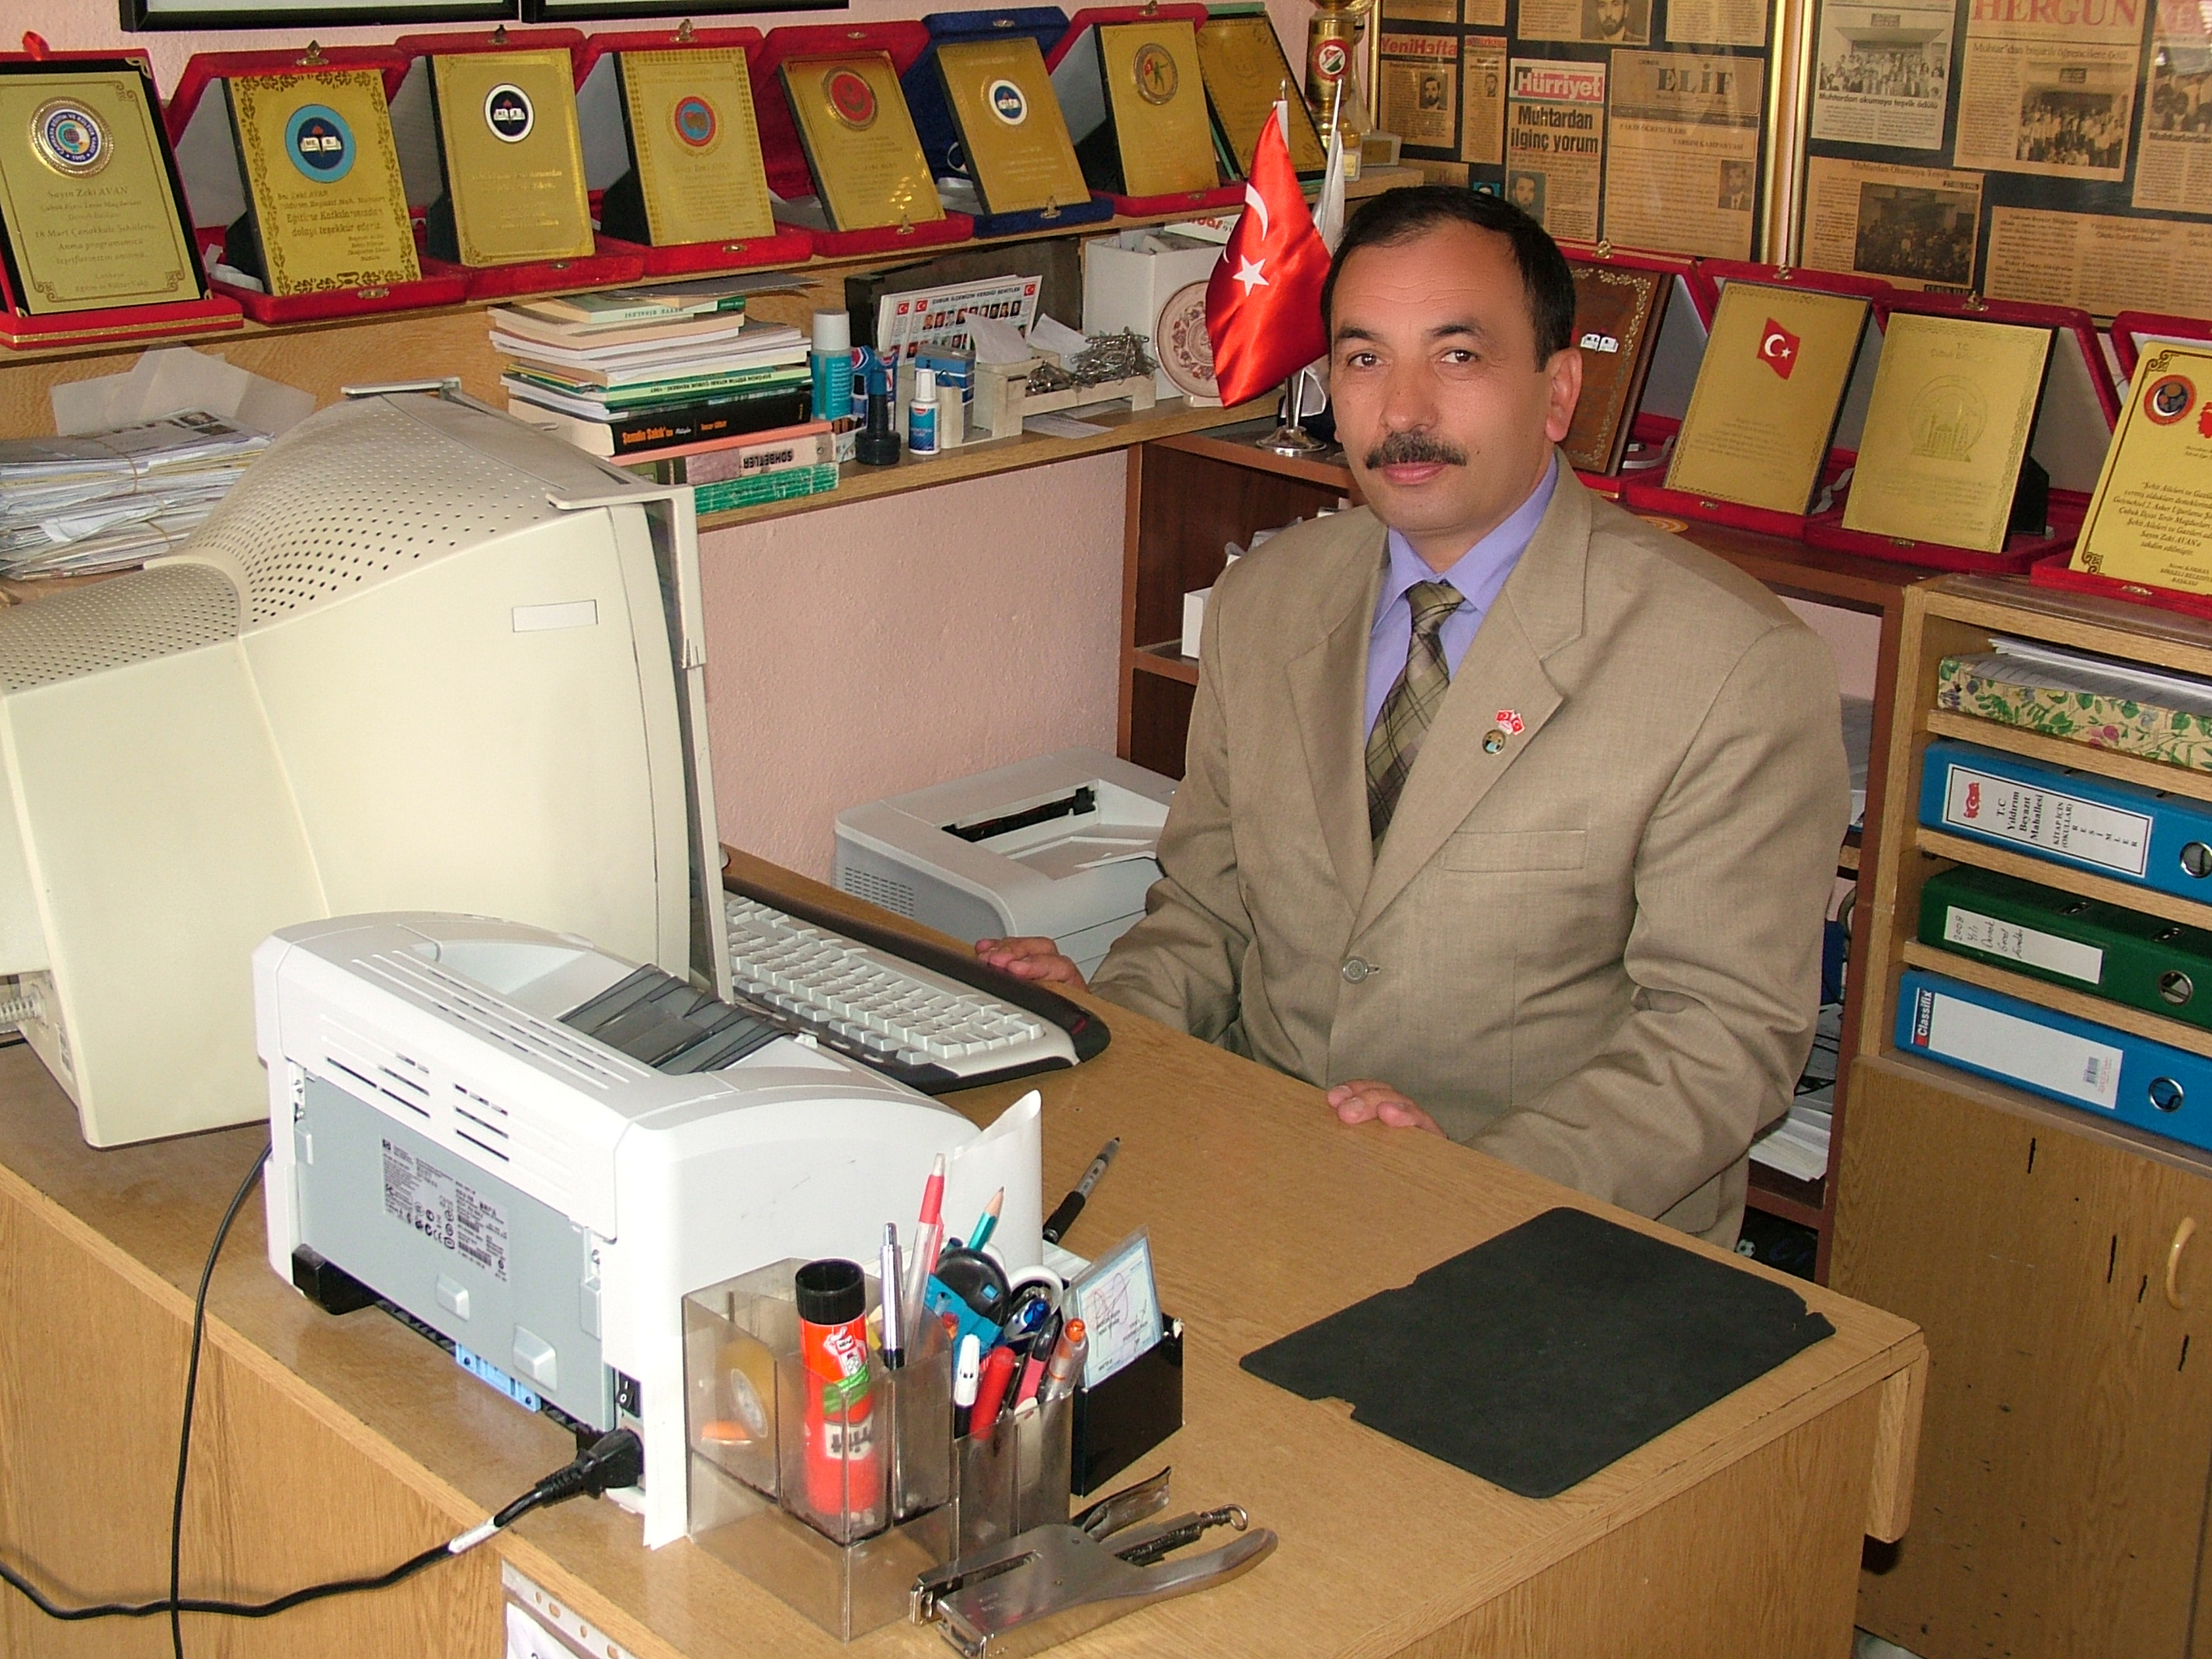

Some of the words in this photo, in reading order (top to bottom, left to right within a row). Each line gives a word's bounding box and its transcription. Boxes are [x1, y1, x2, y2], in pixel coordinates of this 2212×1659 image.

[1518, 71, 1601, 99] Hürriyet
[1818, 92, 1858, 103] Muhtardan
[1859, 96, 1892, 107] okumaya
[1518, 106, 1593, 130] Muhtardan
[1511, 127, 1549, 151] ilginç
[1553, 134, 1598, 154] yorum
[743, 450, 793, 469] SOHBETLER
[2007, 791, 2019, 830] Yıldırım
[2019, 797, 2031, 833] Beyazıt
[2030, 794, 2043, 841] Mahallesi
[2062, 803, 2074, 848] (OKULLAR)
[1917, 989, 1932, 1037] Classifix
